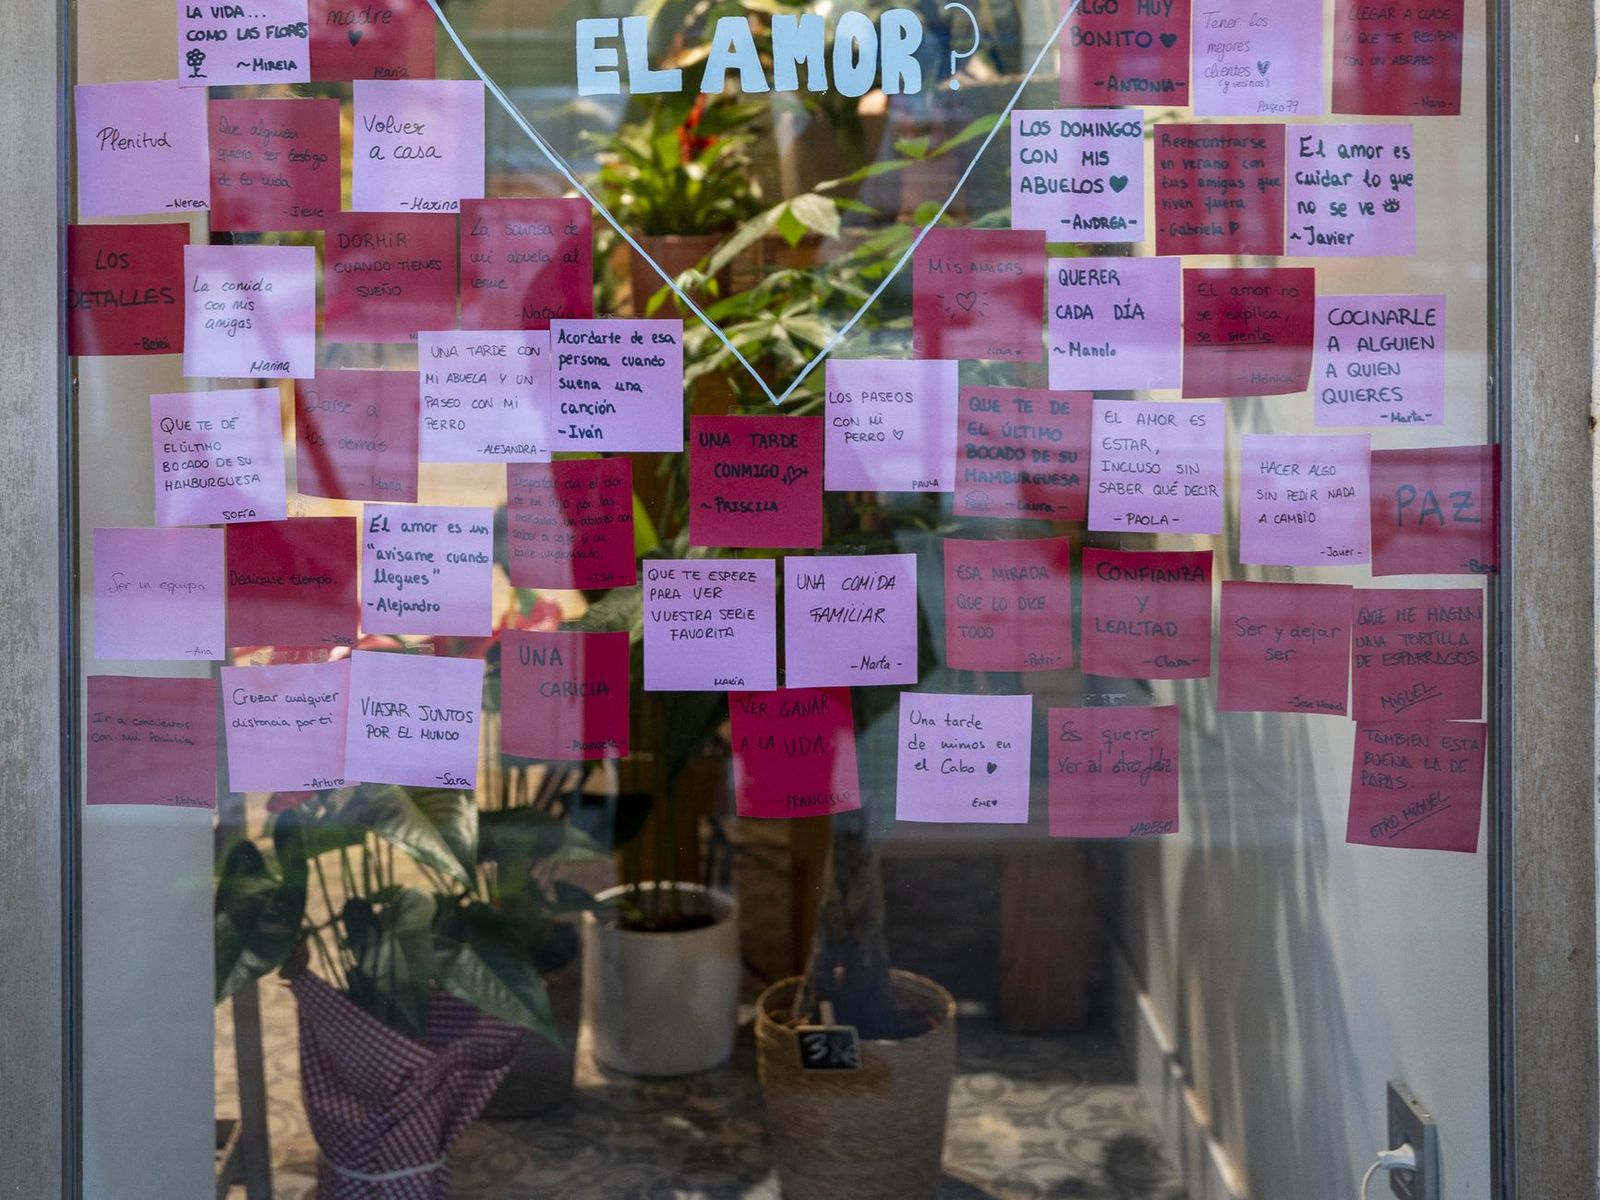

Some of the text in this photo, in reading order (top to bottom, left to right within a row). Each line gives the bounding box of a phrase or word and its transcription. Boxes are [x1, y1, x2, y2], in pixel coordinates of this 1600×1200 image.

[1069, 25, 1153, 49] BONITO
[576, 17, 682, 95] EL
[362, 114, 426, 136] Volver
[1019, 119, 1143, 138] LOS DOMINGOS
[95, 126, 173, 152] Plenitud
[368, 145, 443, 161] a casa
[1019, 147, 1110, 167] CON MIS
[1020, 175, 1105, 195] ABUELOS
[1058, 268, 1121, 287] QUERER
[1055, 297, 1145, 321] CADA DÍA
[1327, 307, 1437, 327] COCINARLE
[557, 328, 677, 345] Acordarte de esa
[1327, 335, 1435, 353] A ALGUIEN
[558, 353, 666, 372] persona cuando
[1325, 361, 1401, 379] A QUIEN
[558, 377, 644, 394] suena una
[1321, 386, 1404, 405] QUIERES
[560, 399, 617, 416] canción
[698, 431, 799, 450] UNA TARDE
[713, 462, 780, 479] CONMIGO
[1395, 484, 1482, 528] PAZ
[796, 573, 825, 592] UNA
[1095, 616, 1179, 641] LEALTAD
[361, 696, 474, 724] VIAJAR JUNTOS
[909, 709, 984, 730] Una tarde
[365, 723, 460, 741] POR EL MUNDO
[907, 732, 926, 751] de
[995, 740, 1012, 750] en
[913, 757, 976, 775] el Cabo
